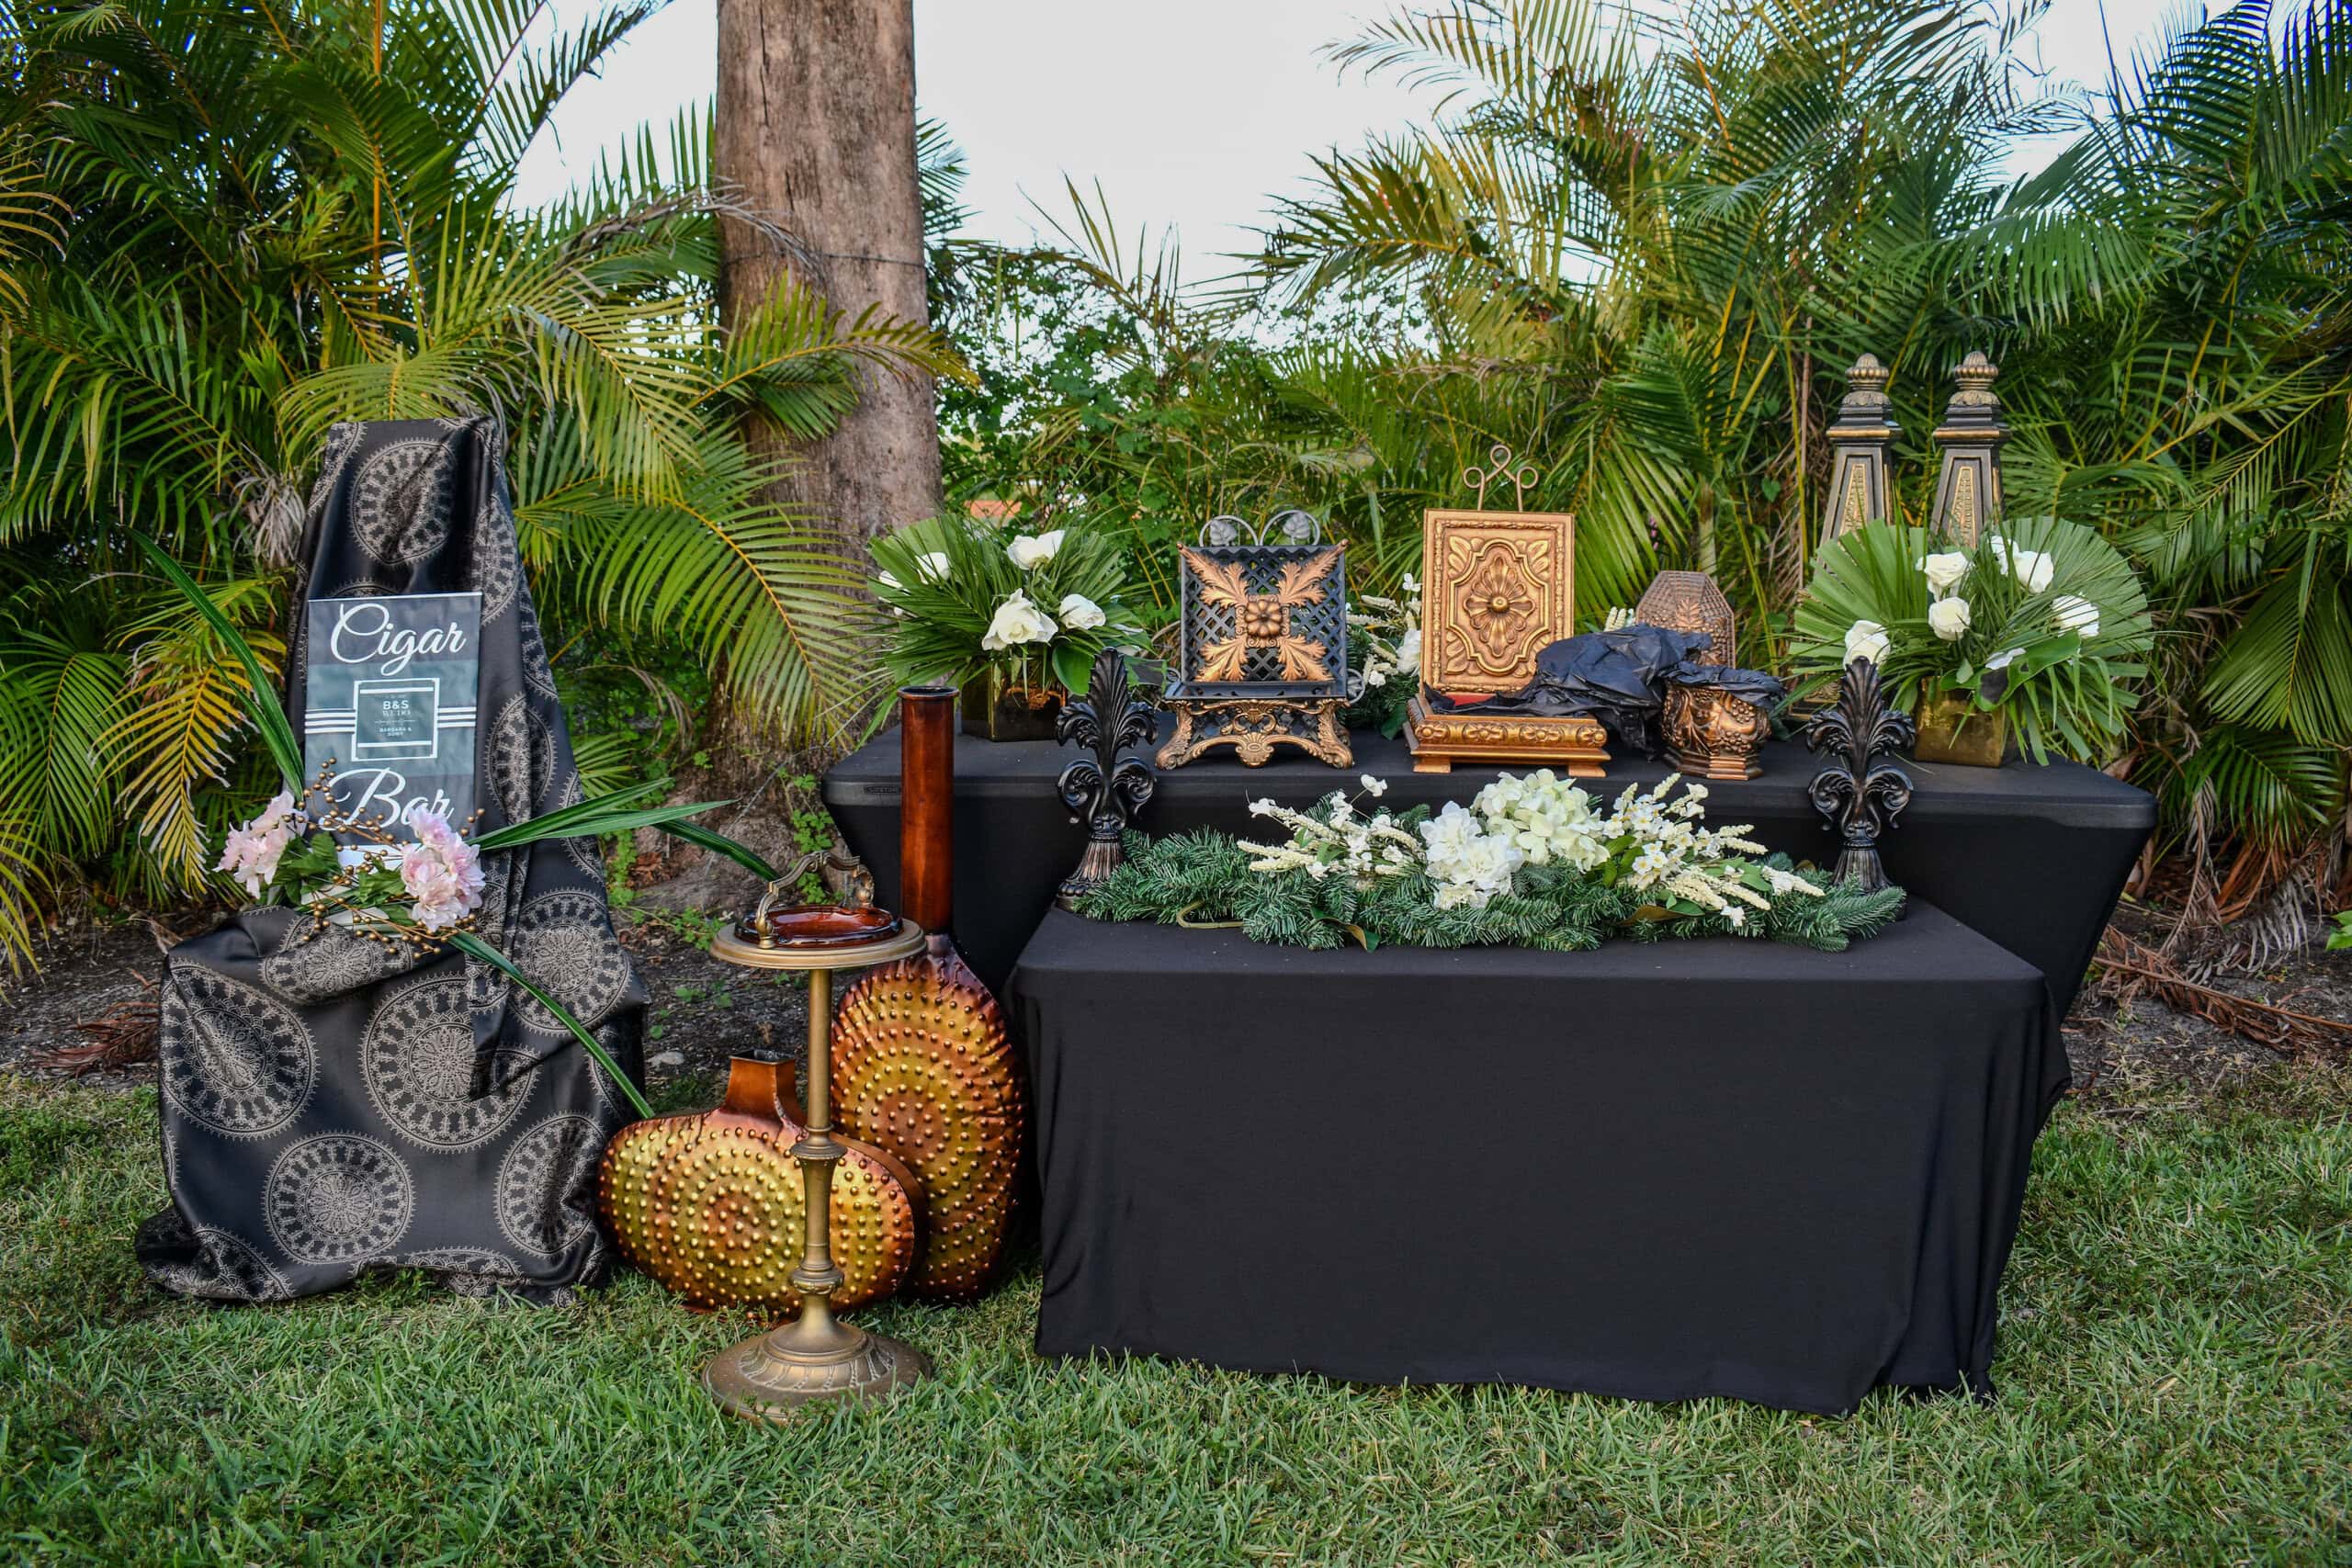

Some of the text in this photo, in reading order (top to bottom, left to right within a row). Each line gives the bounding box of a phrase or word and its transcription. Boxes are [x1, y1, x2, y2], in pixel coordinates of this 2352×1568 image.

[330, 603, 467, 677] Cigar
[382, 699, 410, 710] B&S
[318, 766, 455, 831] Bar
